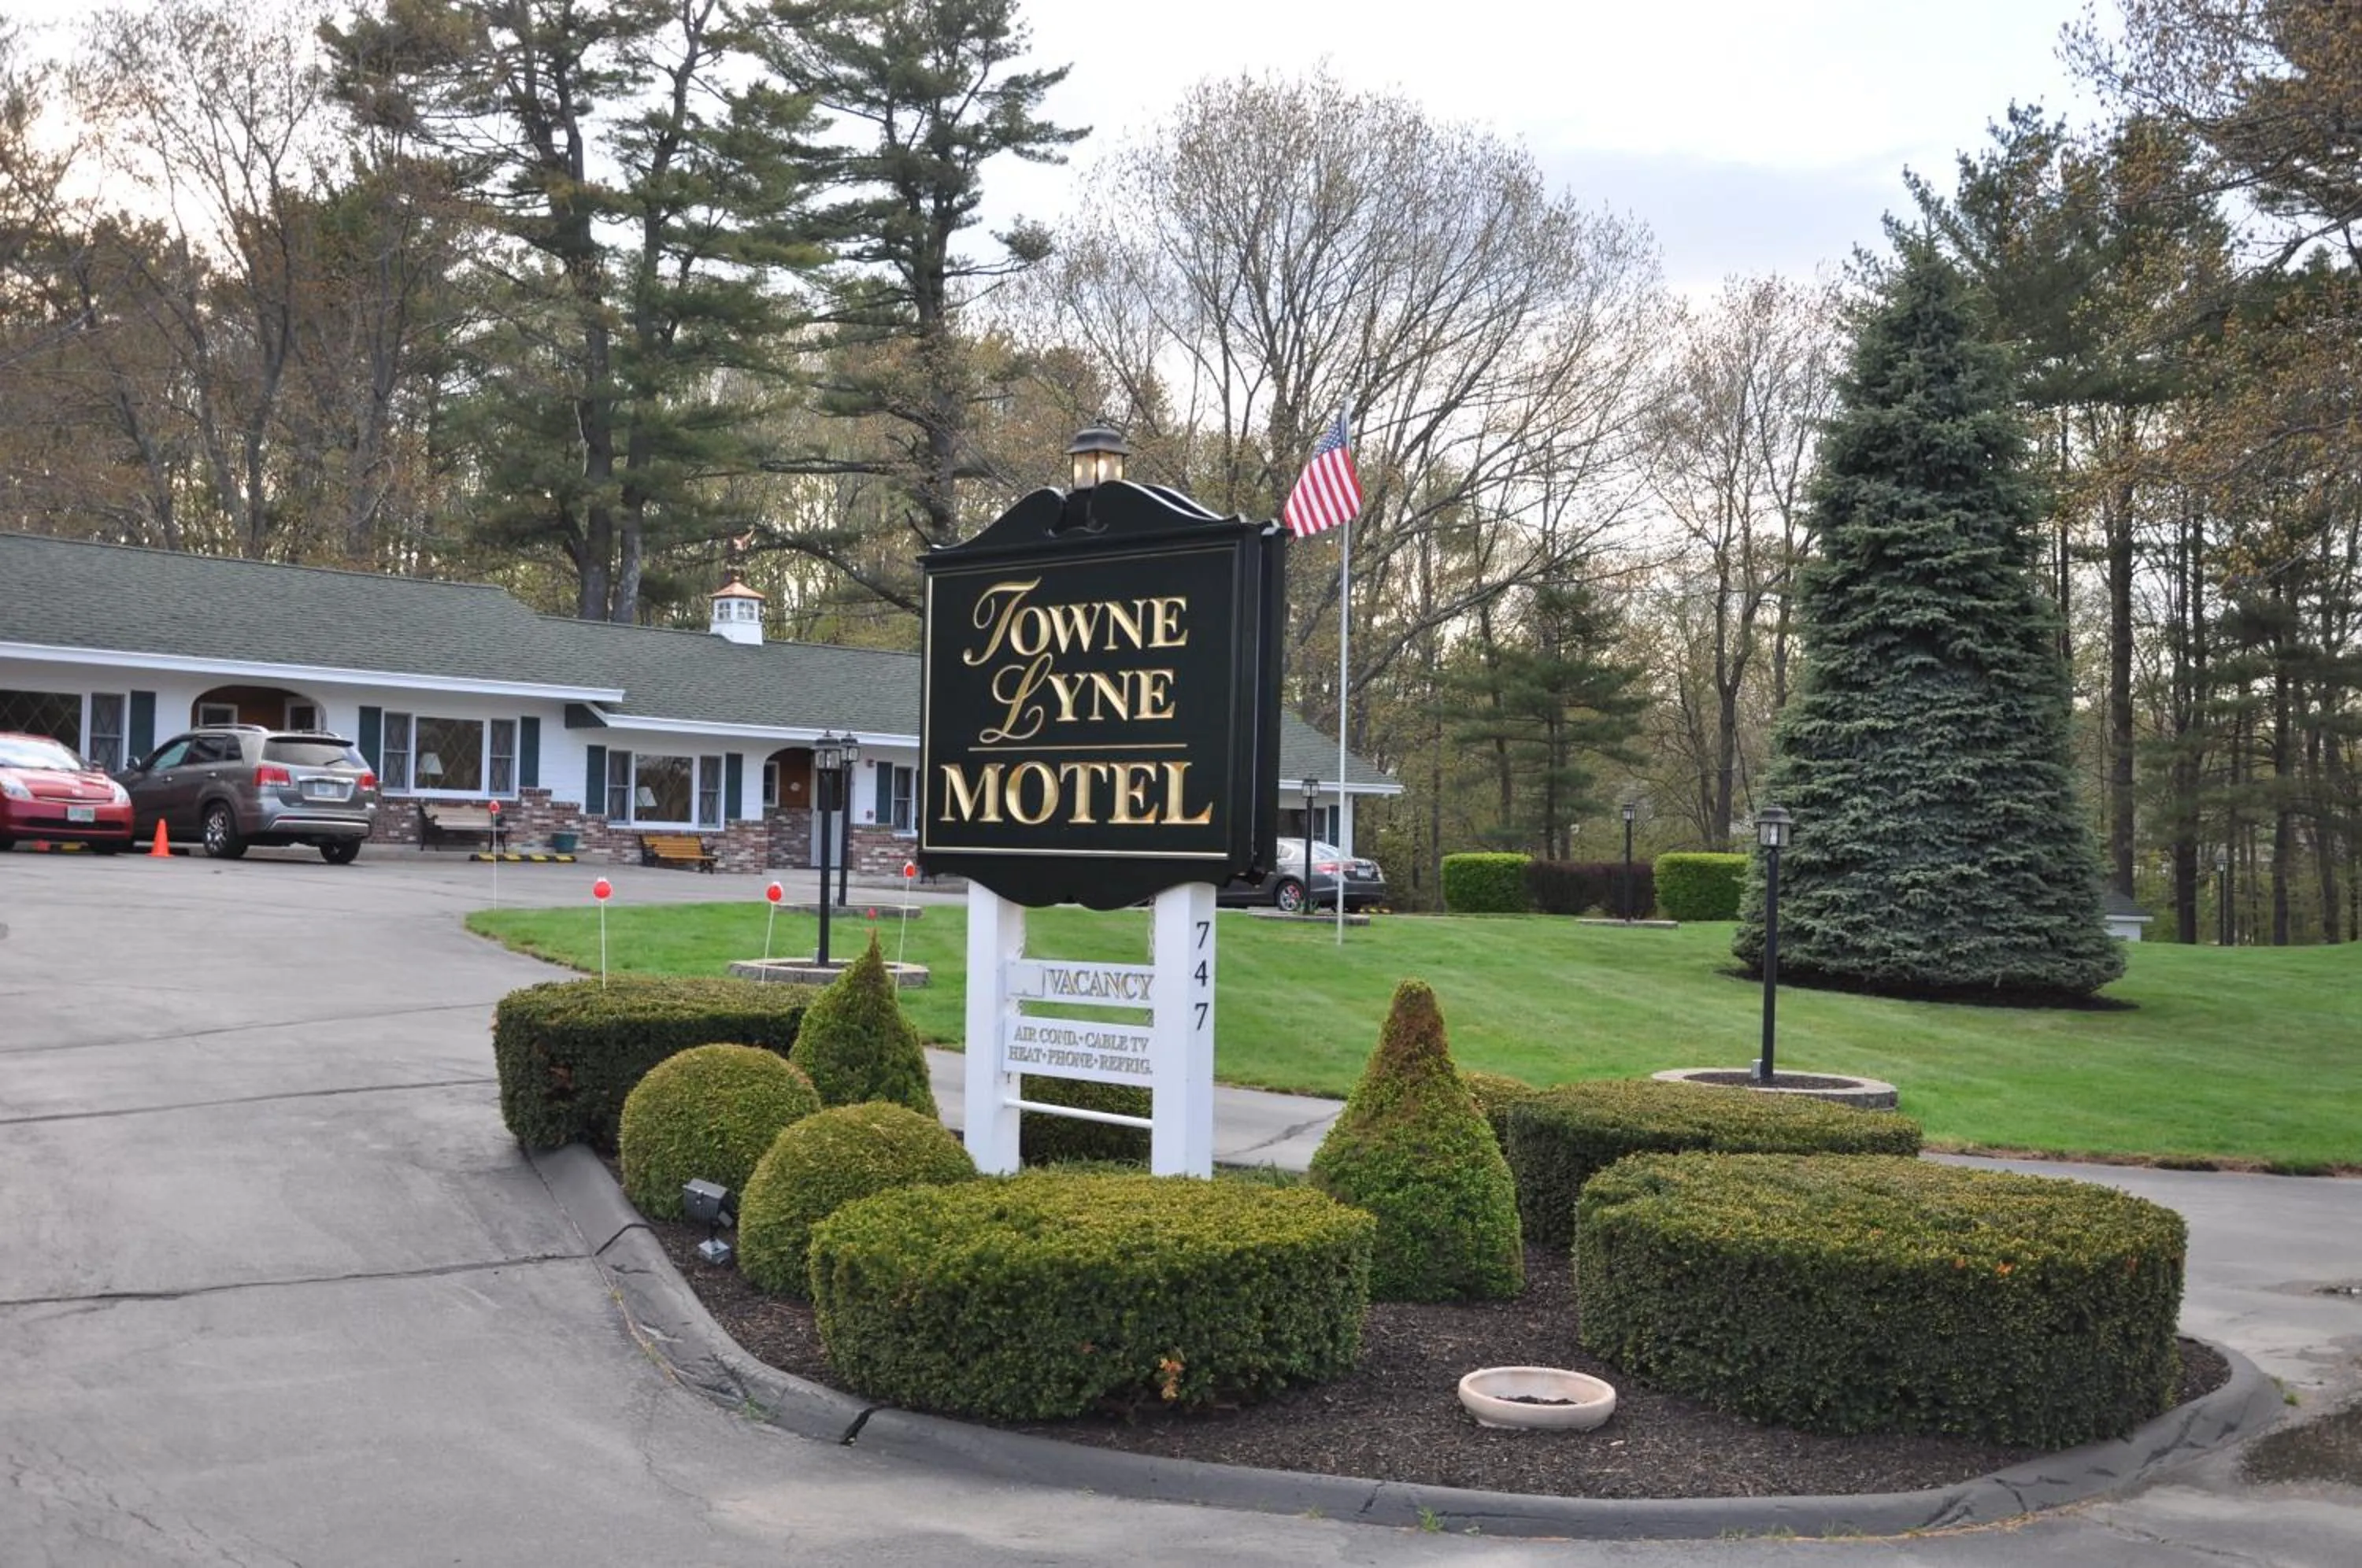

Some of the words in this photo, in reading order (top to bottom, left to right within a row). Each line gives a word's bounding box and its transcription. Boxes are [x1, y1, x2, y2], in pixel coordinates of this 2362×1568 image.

[963, 576, 1188, 665] TOWNE
[979, 653, 1176, 743] LYNE
[939, 761, 1213, 825] MOTEL
[1047, 969, 1154, 1000] VACANCY
[1014, 1025, 1037, 1043] AIR
[1085, 1032, 1128, 1052] CABLE
[1131, 1036, 1150, 1052] TV
